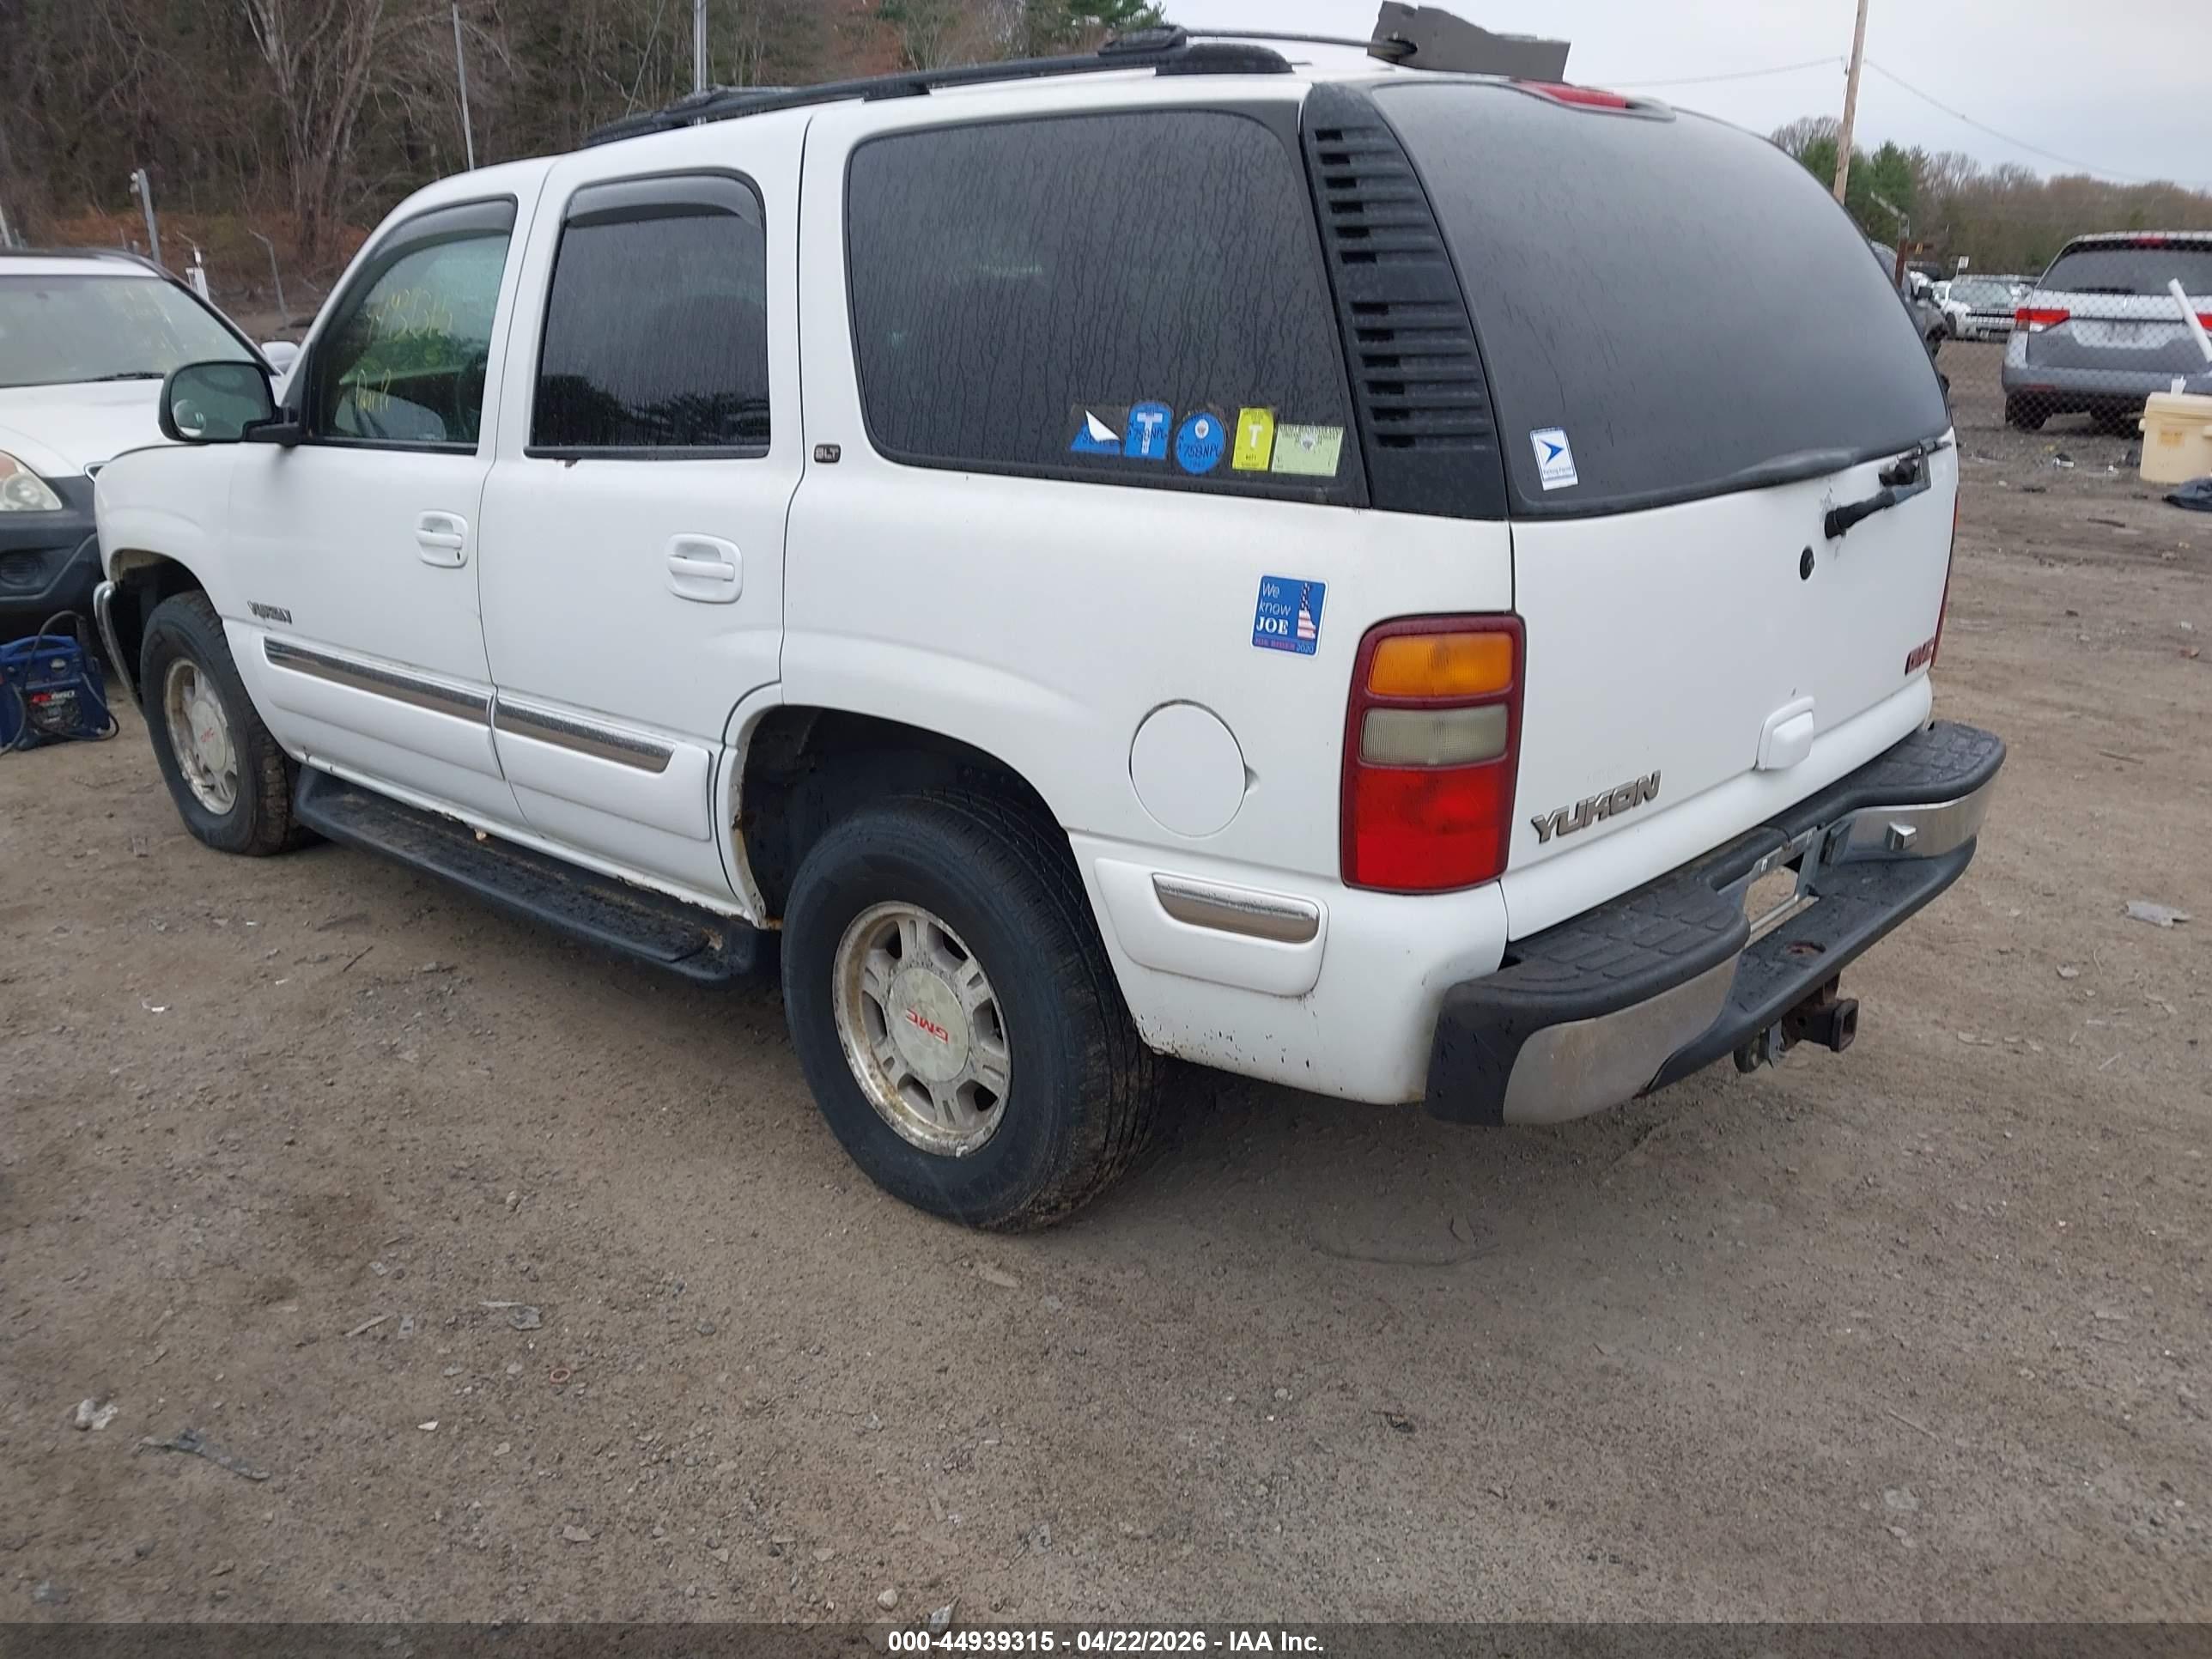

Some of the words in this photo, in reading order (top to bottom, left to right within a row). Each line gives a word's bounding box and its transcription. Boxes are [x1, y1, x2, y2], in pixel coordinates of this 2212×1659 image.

[1137, 412, 1163, 454] T
[1249, 424, 1263, 449] T
[1262, 581, 1280, 599] We
[1259, 599, 1291, 616] know
[1256, 616, 1288, 635] JOE
[1531, 769, 1662, 844] YUKON
[906, 1006, 950, 1045] GMC
